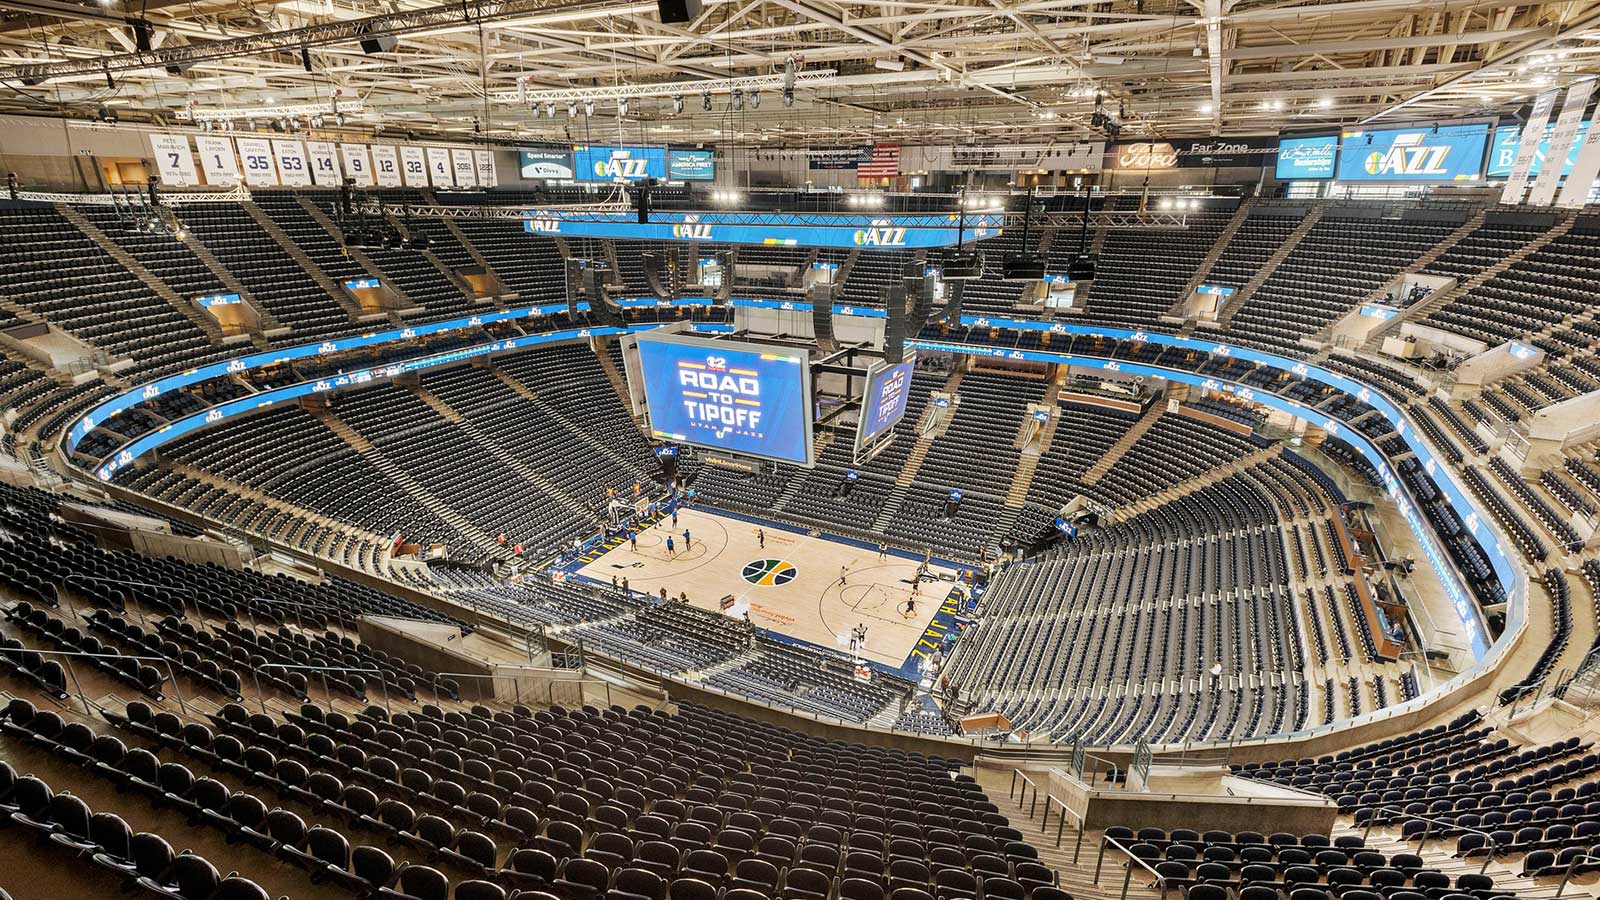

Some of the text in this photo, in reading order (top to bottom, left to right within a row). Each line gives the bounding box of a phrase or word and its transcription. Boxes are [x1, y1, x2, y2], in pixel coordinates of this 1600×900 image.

[1120, 142, 1182, 167] Ford
[1217, 142, 1248, 153] Zone
[1365, 133, 1451, 175] JAZZ
[168, 153, 180, 168] 7
[214, 154, 224, 169] 1
[246, 155, 269, 170] 35
[281, 156, 302, 170] 53
[317, 157, 334, 171] 14
[352, 159, 362, 172] 9
[379, 160, 394, 173] 12
[406, 161, 422, 173] 32
[437, 162, 445, 173] 4
[594, 151, 649, 177] JAZZ
[854, 219, 906, 246] JAZZ
[679, 369, 760, 396] ROAD
[882, 376, 904, 397] ROAD
[708, 391, 733, 405] TO
[684, 400, 761, 429] TIPOFF
[690, 421, 717, 430] UTAH
[578, 537, 626, 564] UTAH
[911, 619, 948, 659] JAZZ
